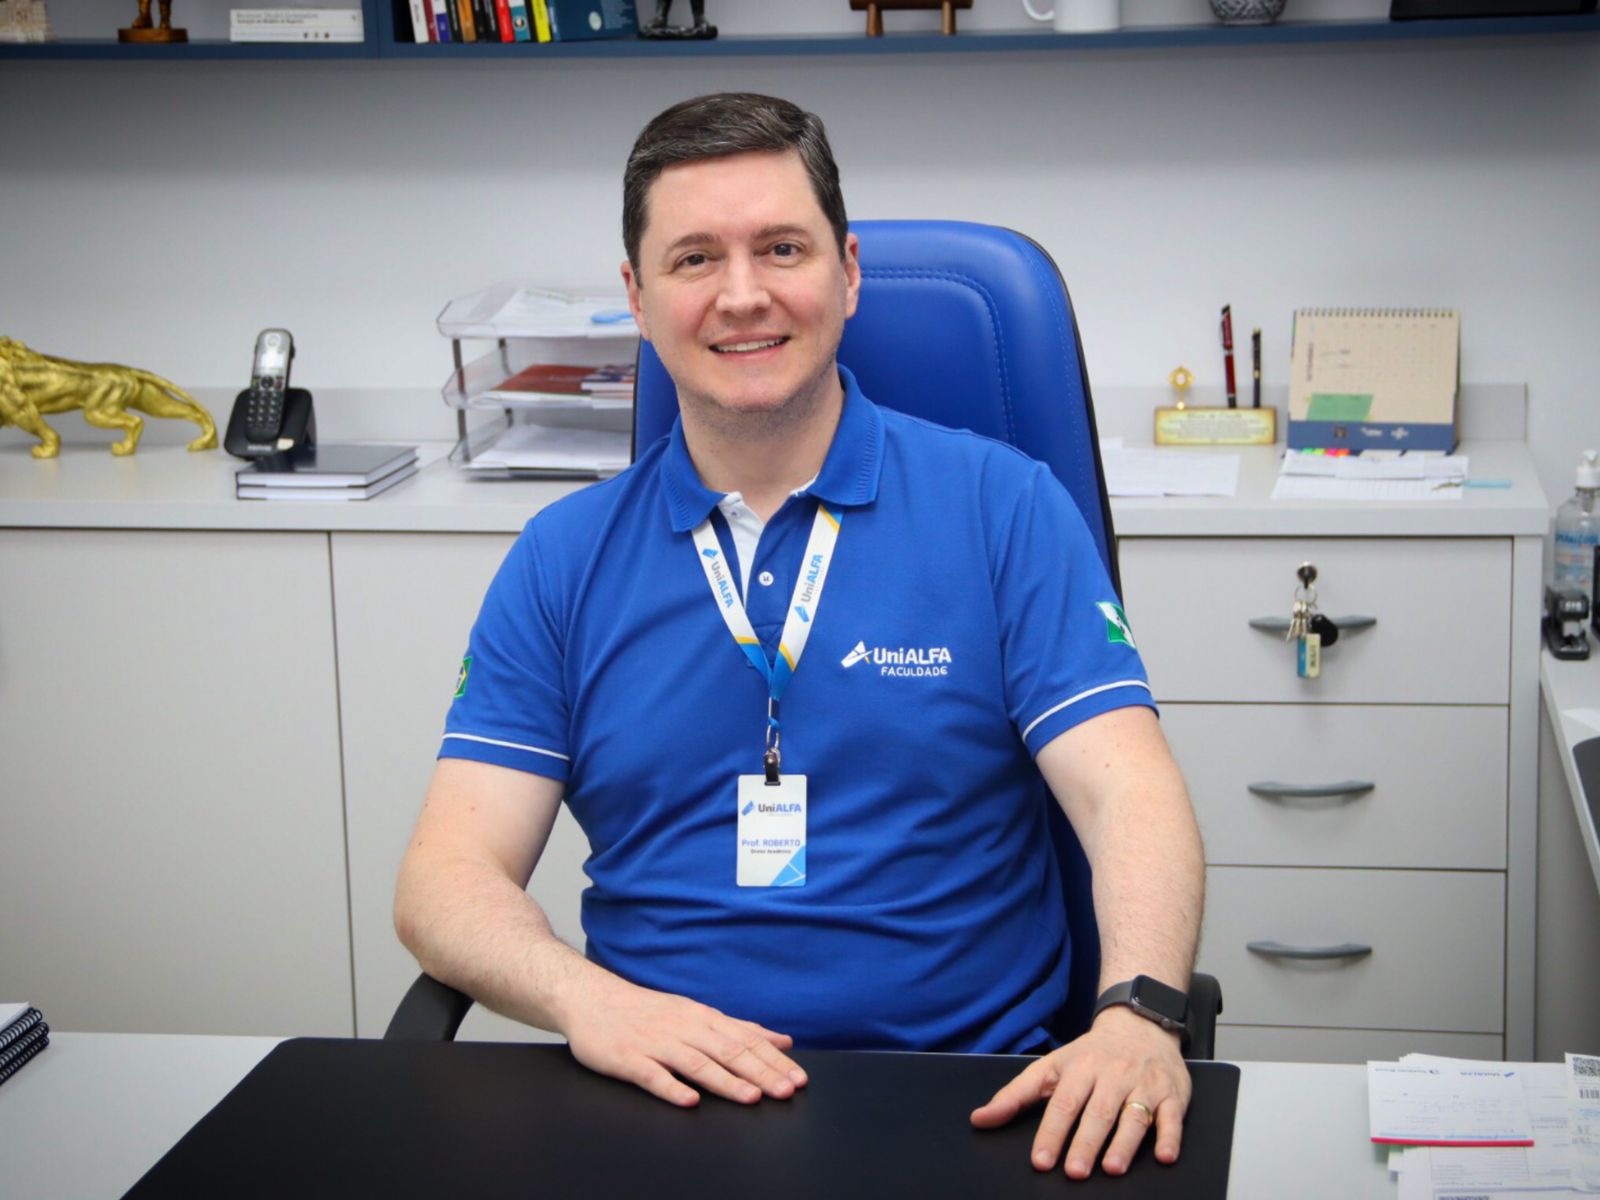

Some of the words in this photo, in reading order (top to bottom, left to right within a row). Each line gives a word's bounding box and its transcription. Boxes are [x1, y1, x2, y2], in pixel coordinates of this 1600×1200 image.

[710, 561, 734, 609] UniALFA
[801, 554, 824, 603] UniALFA
[873, 647, 952, 665] UniALFA
[881, 666, 949, 677] FACULDADE
[758, 803, 802, 813] UniALFA
[763, 839, 801, 847] ROBERTO
